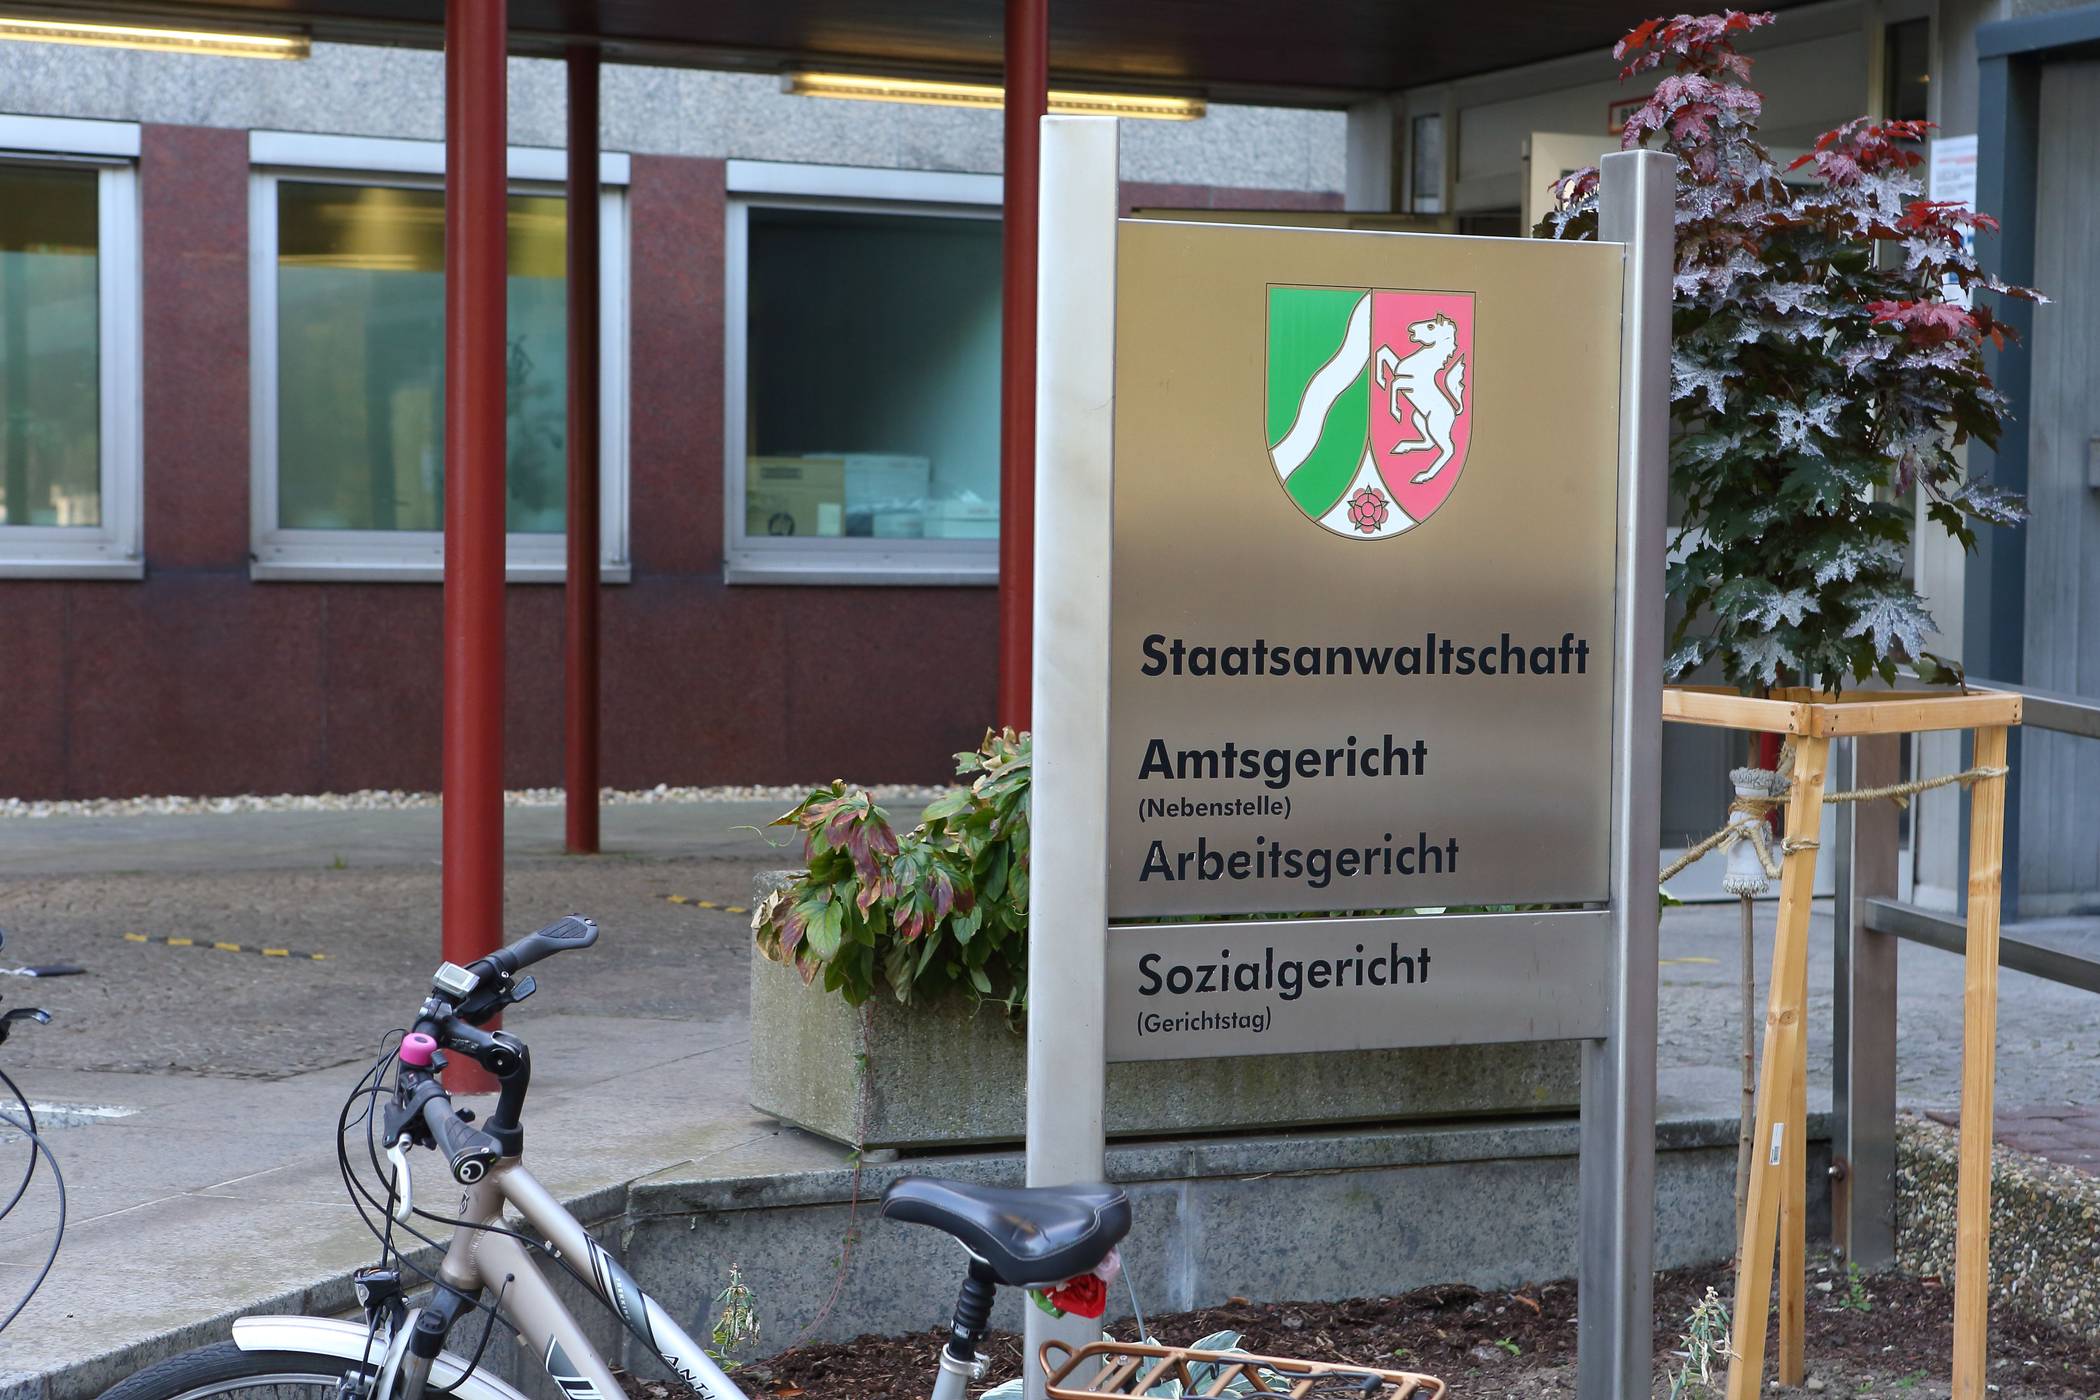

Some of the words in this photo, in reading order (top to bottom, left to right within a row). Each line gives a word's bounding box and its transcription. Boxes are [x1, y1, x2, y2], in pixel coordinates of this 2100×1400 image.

[1141, 633, 1589, 677] Staatsanwaltschaft
[1138, 734, 1427, 789] Amtsgericht
[1138, 796, 1291, 823] (Nebenstelle)
[1139, 832, 1459, 888] Arbeitsgericht
[1137, 944, 1431, 1001] Sozialgericht
[1136, 1007, 1272, 1036] (Gerichtstag)
